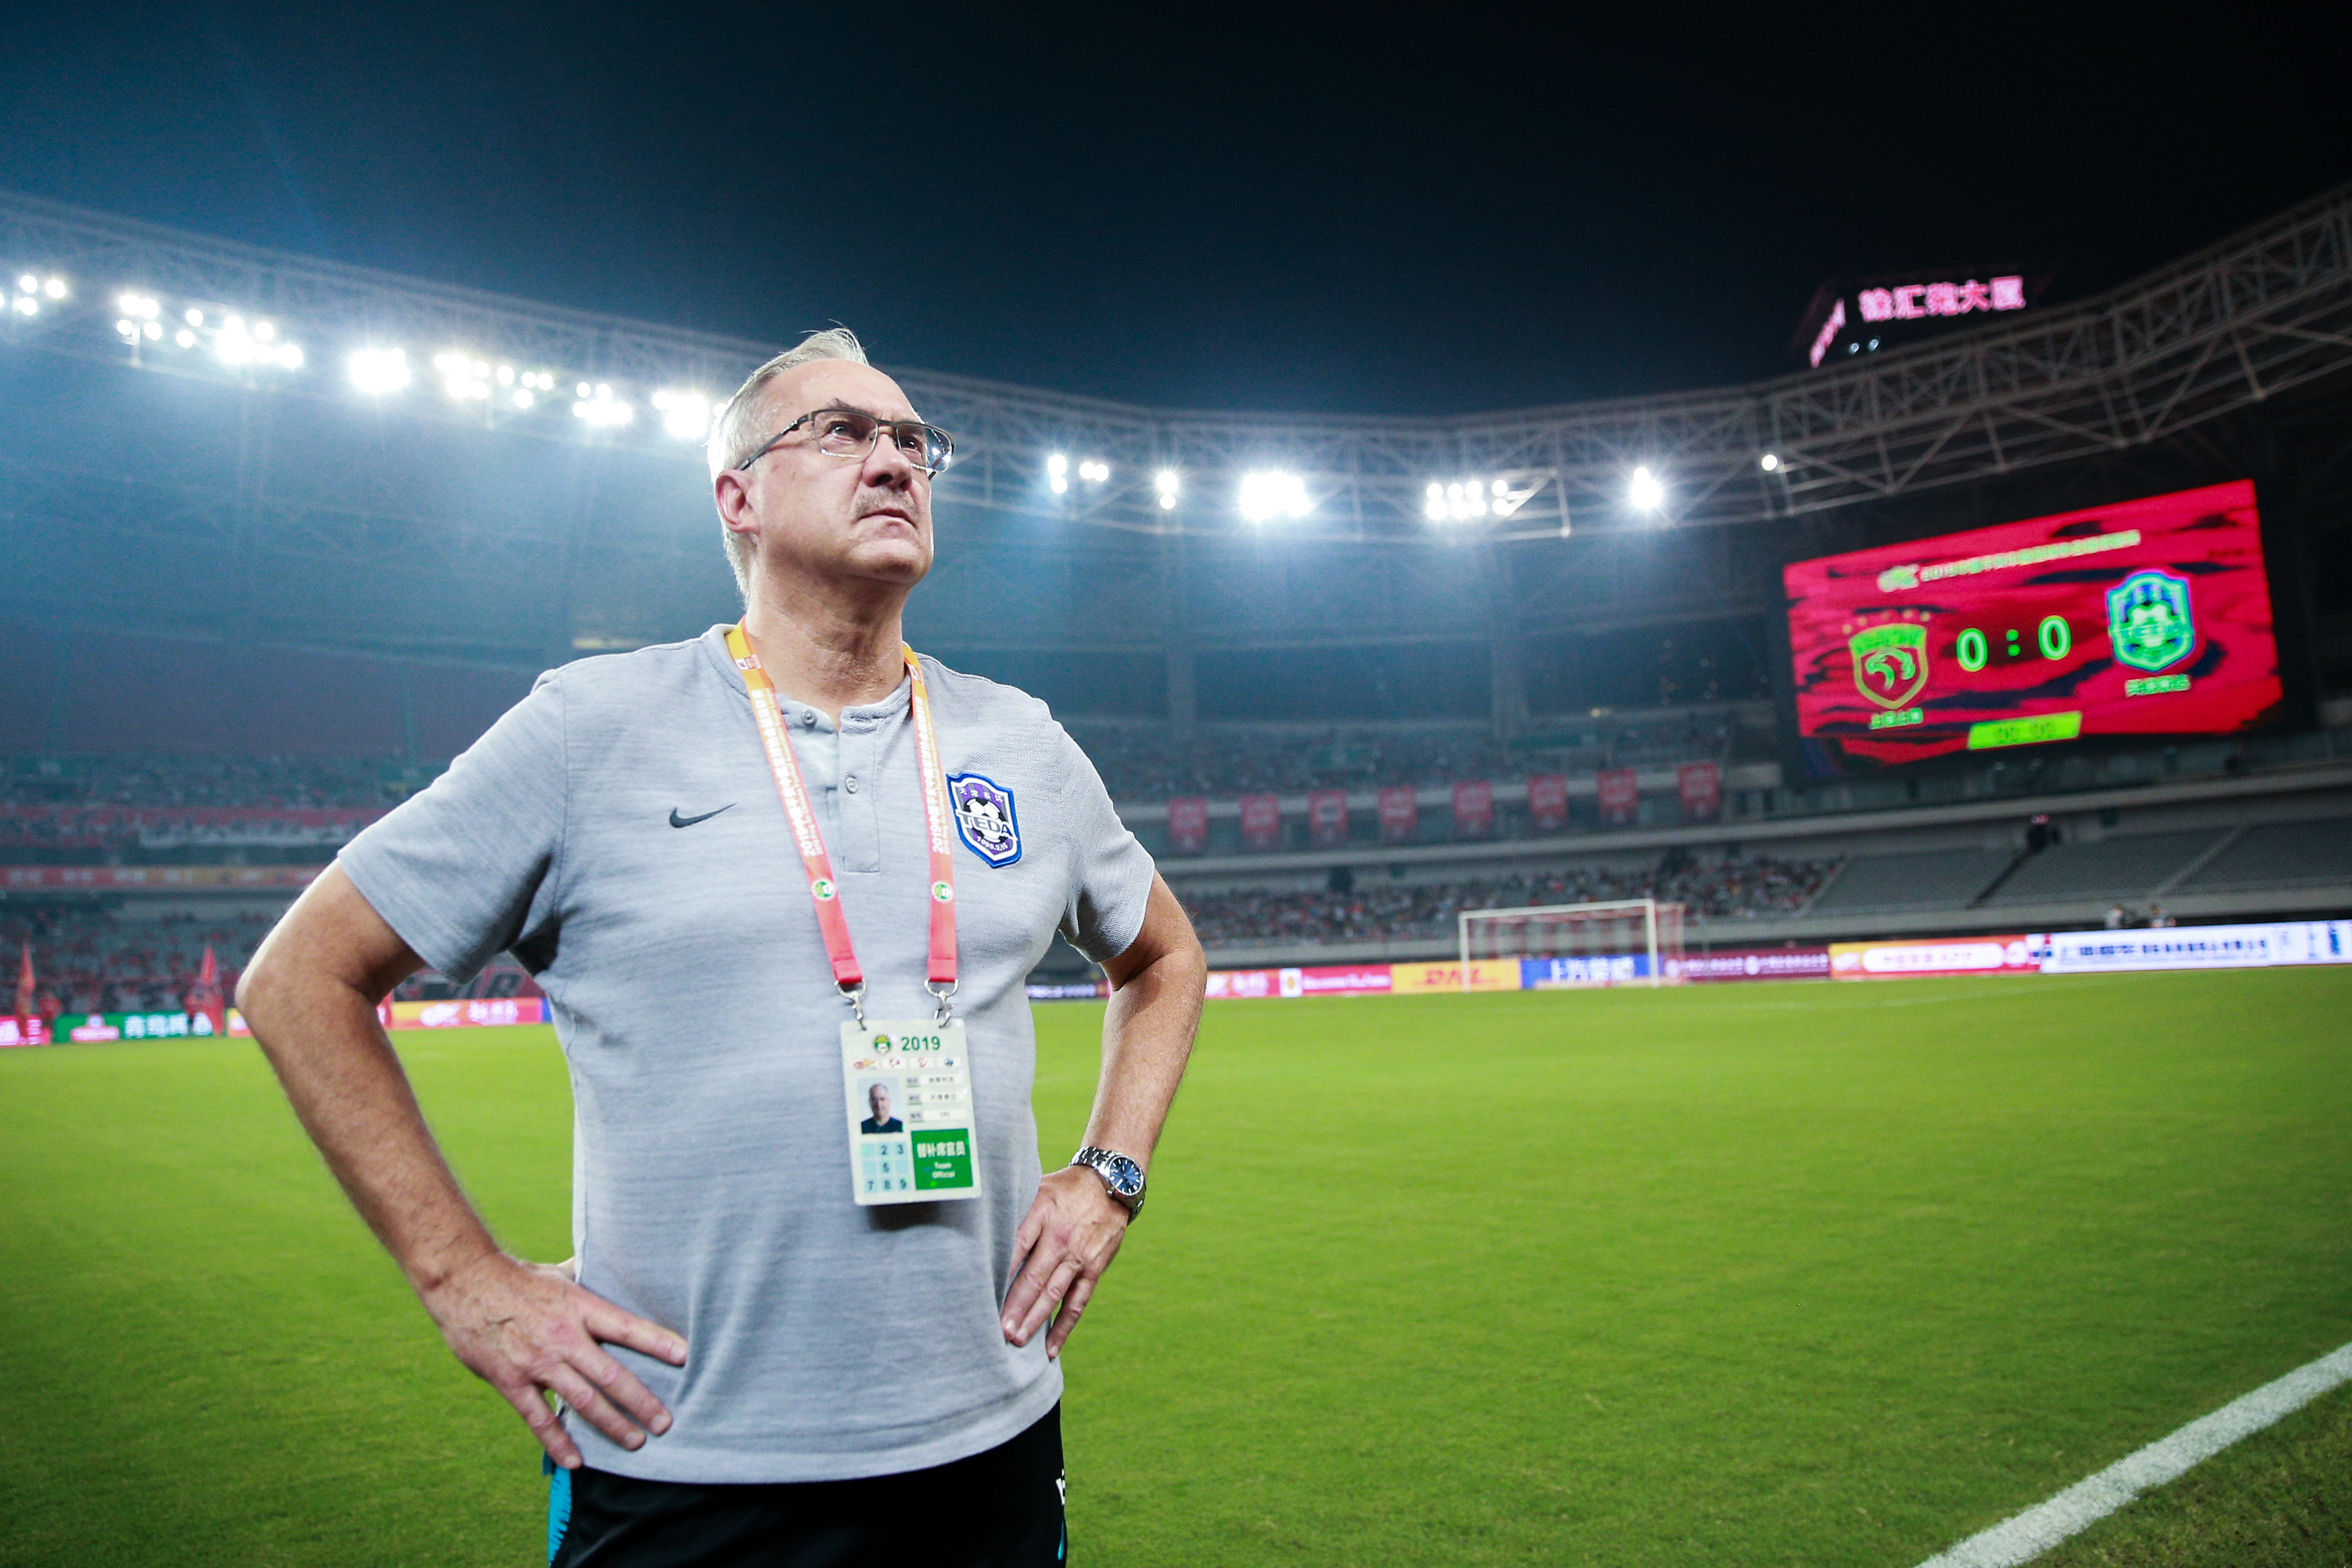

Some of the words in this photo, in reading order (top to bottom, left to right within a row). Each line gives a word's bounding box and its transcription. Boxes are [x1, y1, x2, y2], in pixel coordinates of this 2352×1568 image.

[1956, 628, 1988, 672] 0
[2038, 615, 2071, 661] 0
[958, 812, 1014, 837] TEDA
[901, 1036, 940, 1051] 2019
[881, 1145, 888, 1155] 2
[898, 1145, 904, 1154] 3
[867, 1181, 873, 1191] 7
